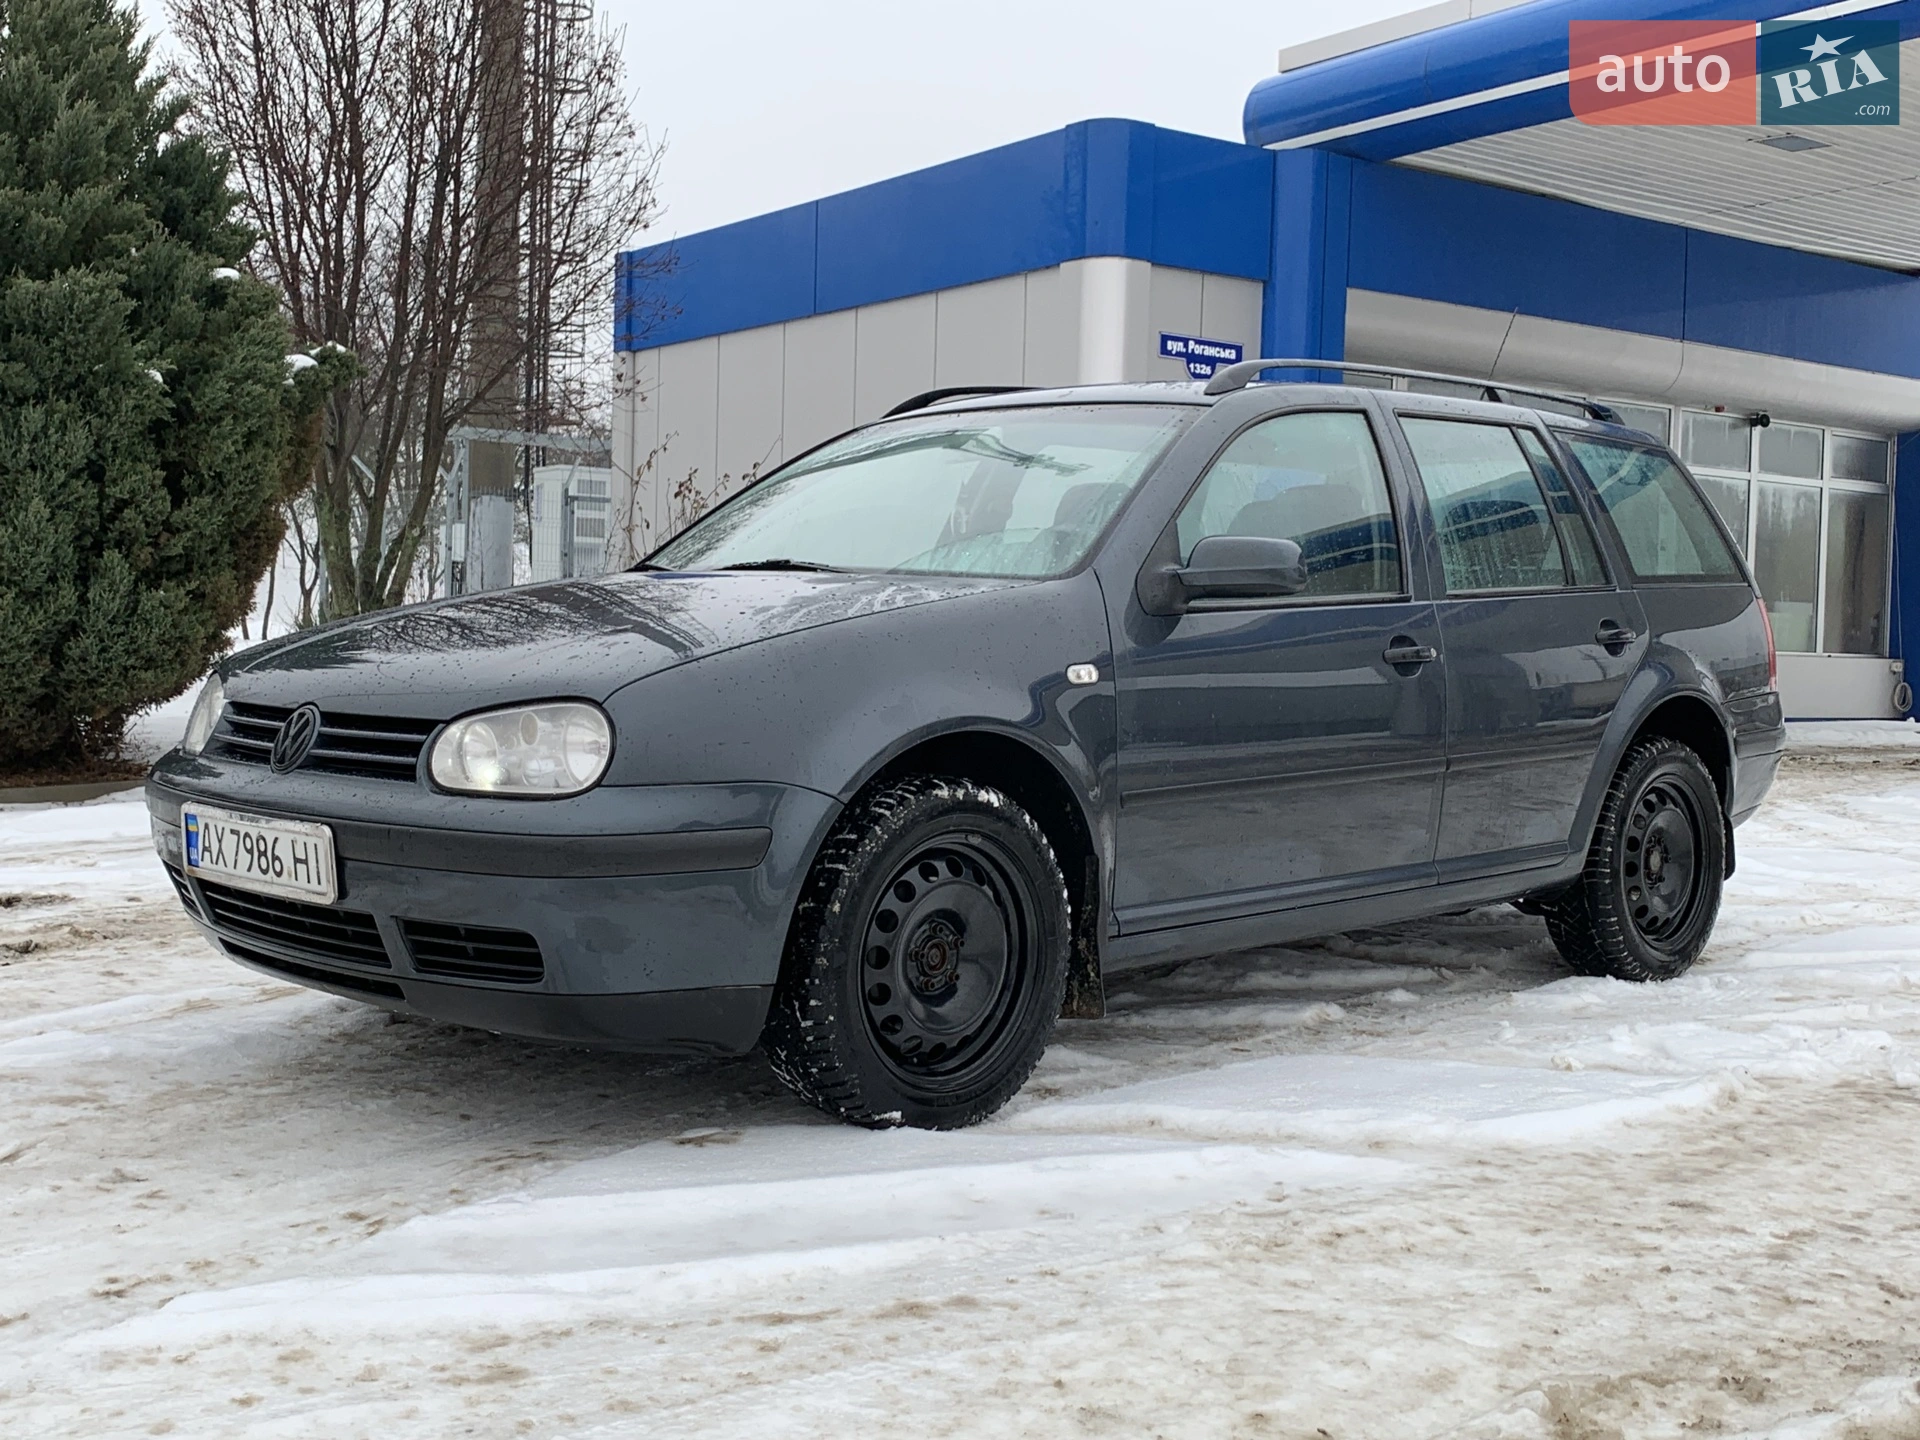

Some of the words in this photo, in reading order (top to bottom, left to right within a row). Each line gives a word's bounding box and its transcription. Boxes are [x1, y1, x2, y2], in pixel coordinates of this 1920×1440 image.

[1166, 340, 1187, 354] вул.
[1188, 340, 1236, 360] Роганська
[230, 828, 284, 878] 7986
